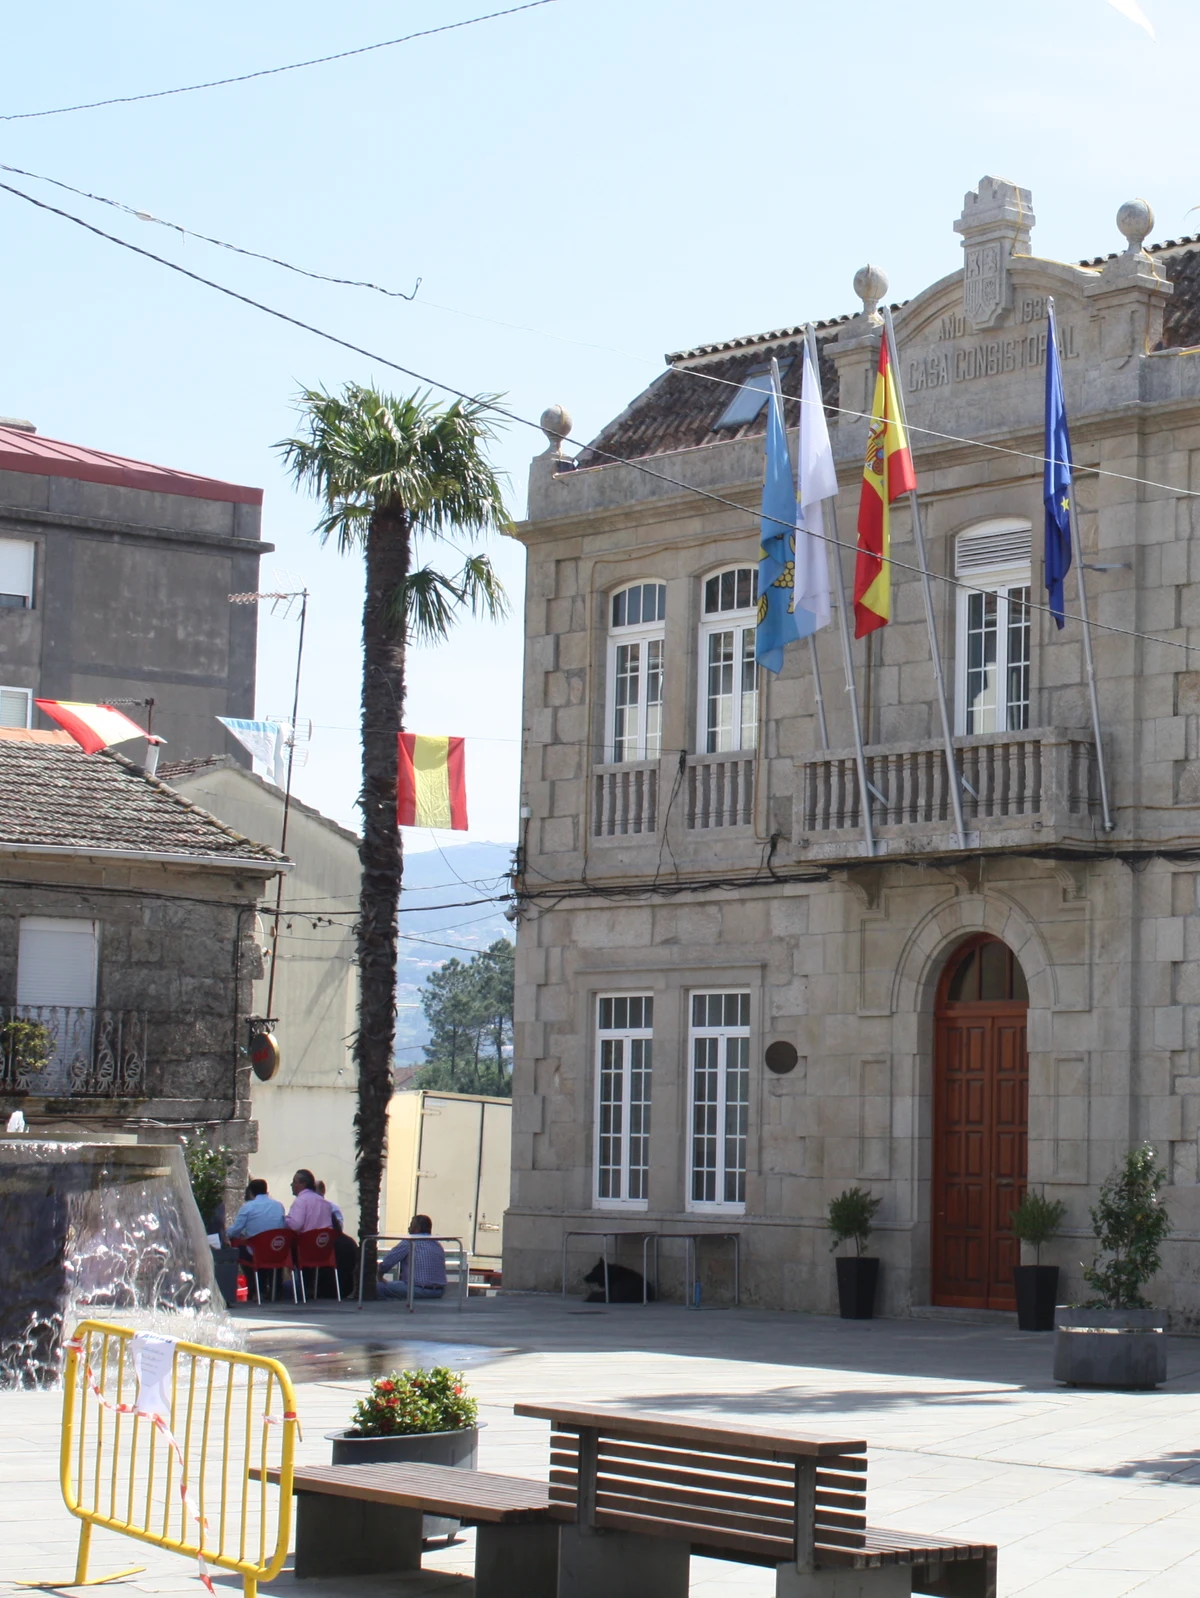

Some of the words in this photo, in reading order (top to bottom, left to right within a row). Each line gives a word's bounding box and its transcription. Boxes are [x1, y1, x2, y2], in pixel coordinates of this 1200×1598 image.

[938, 312, 965, 341] AÑO
[909, 354, 949, 393] CASA
[955, 327, 1079, 382] CONSISTORAL
